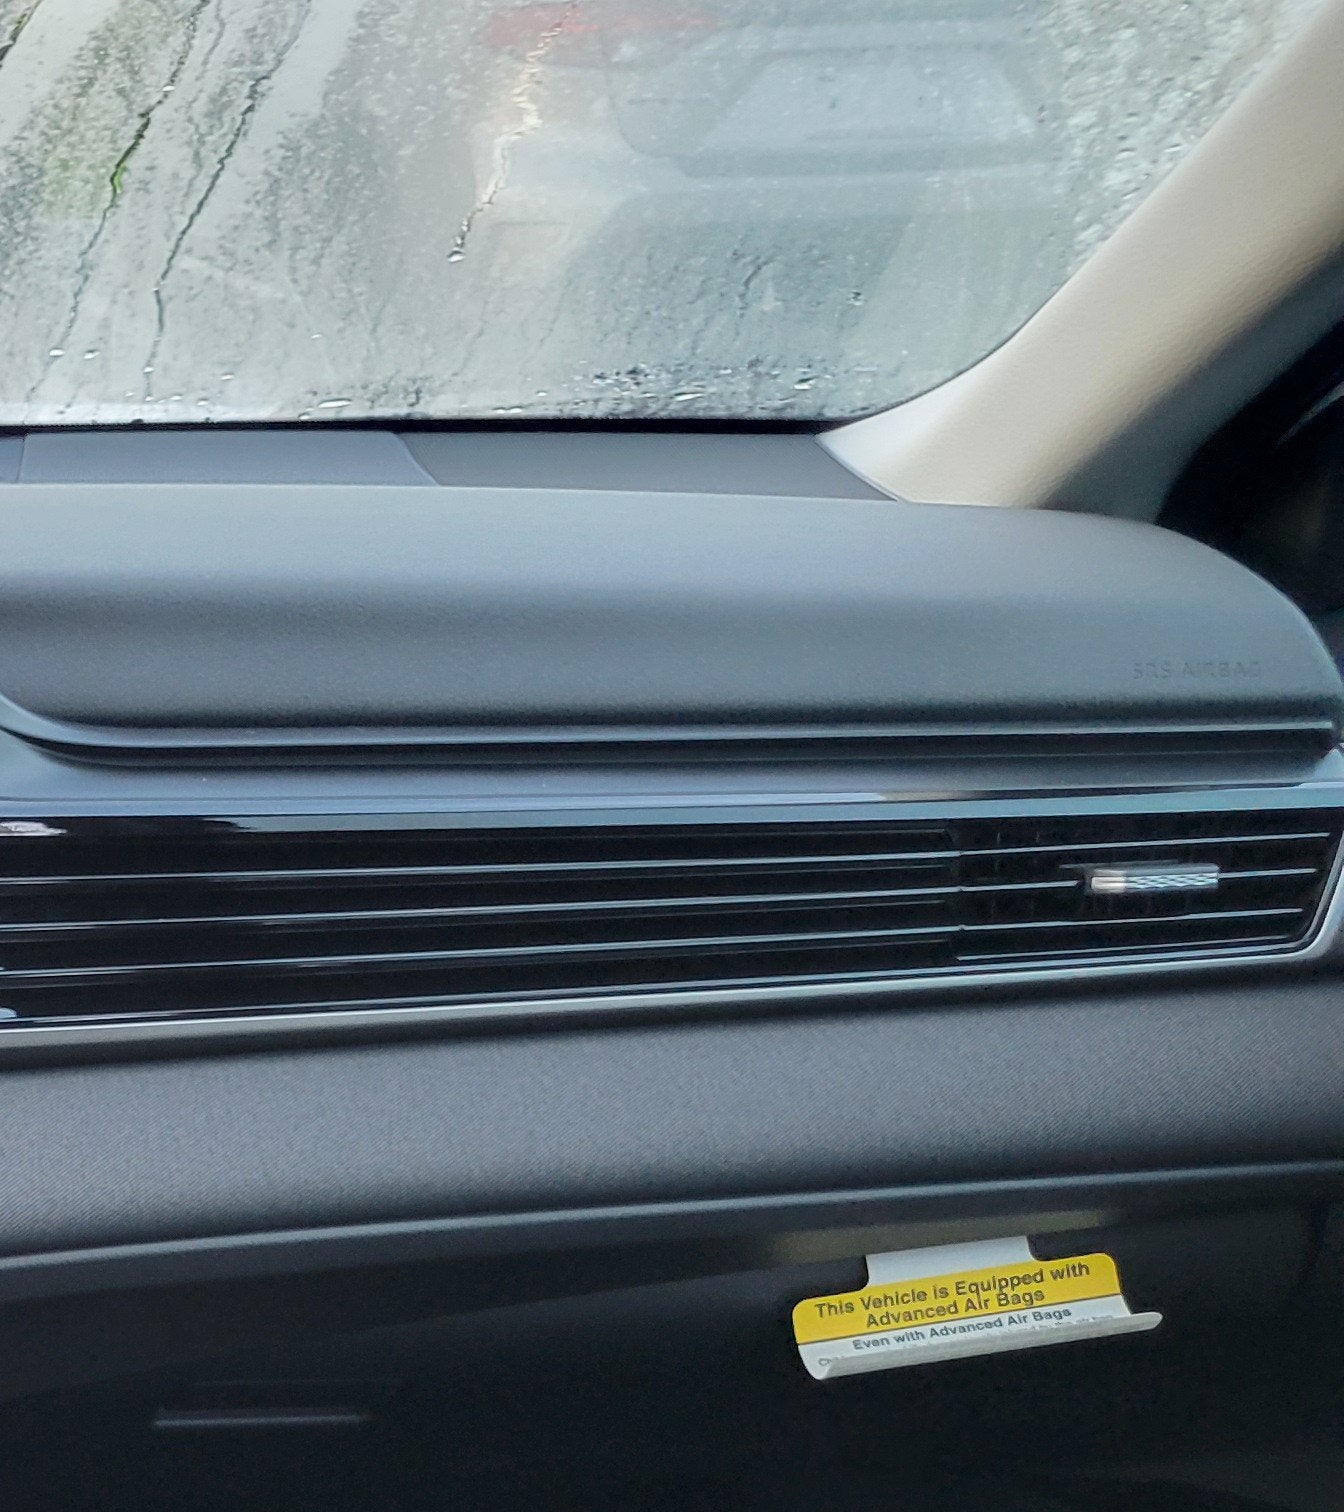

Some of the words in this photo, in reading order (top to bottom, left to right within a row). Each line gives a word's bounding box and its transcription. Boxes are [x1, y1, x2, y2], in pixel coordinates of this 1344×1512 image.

[815, 1300, 855, 1319] This
[861, 1288, 928, 1311] Vehicle
[933, 1285, 949, 1300] is
[955, 1268, 1044, 1299] Equipped
[1050, 1261, 1090, 1280] with
[866, 1300, 959, 1328] Advanced
[964, 1297, 991, 1313] Air
[996, 1289, 1045, 1308] Bags
[852, 1337, 891, 1350] Even
[894, 1330, 926, 1343] with
[929, 1317, 1003, 1339] Advanced
[1007, 1313, 1028, 1326] Air
[1032, 1308, 1072, 1322] Bags
